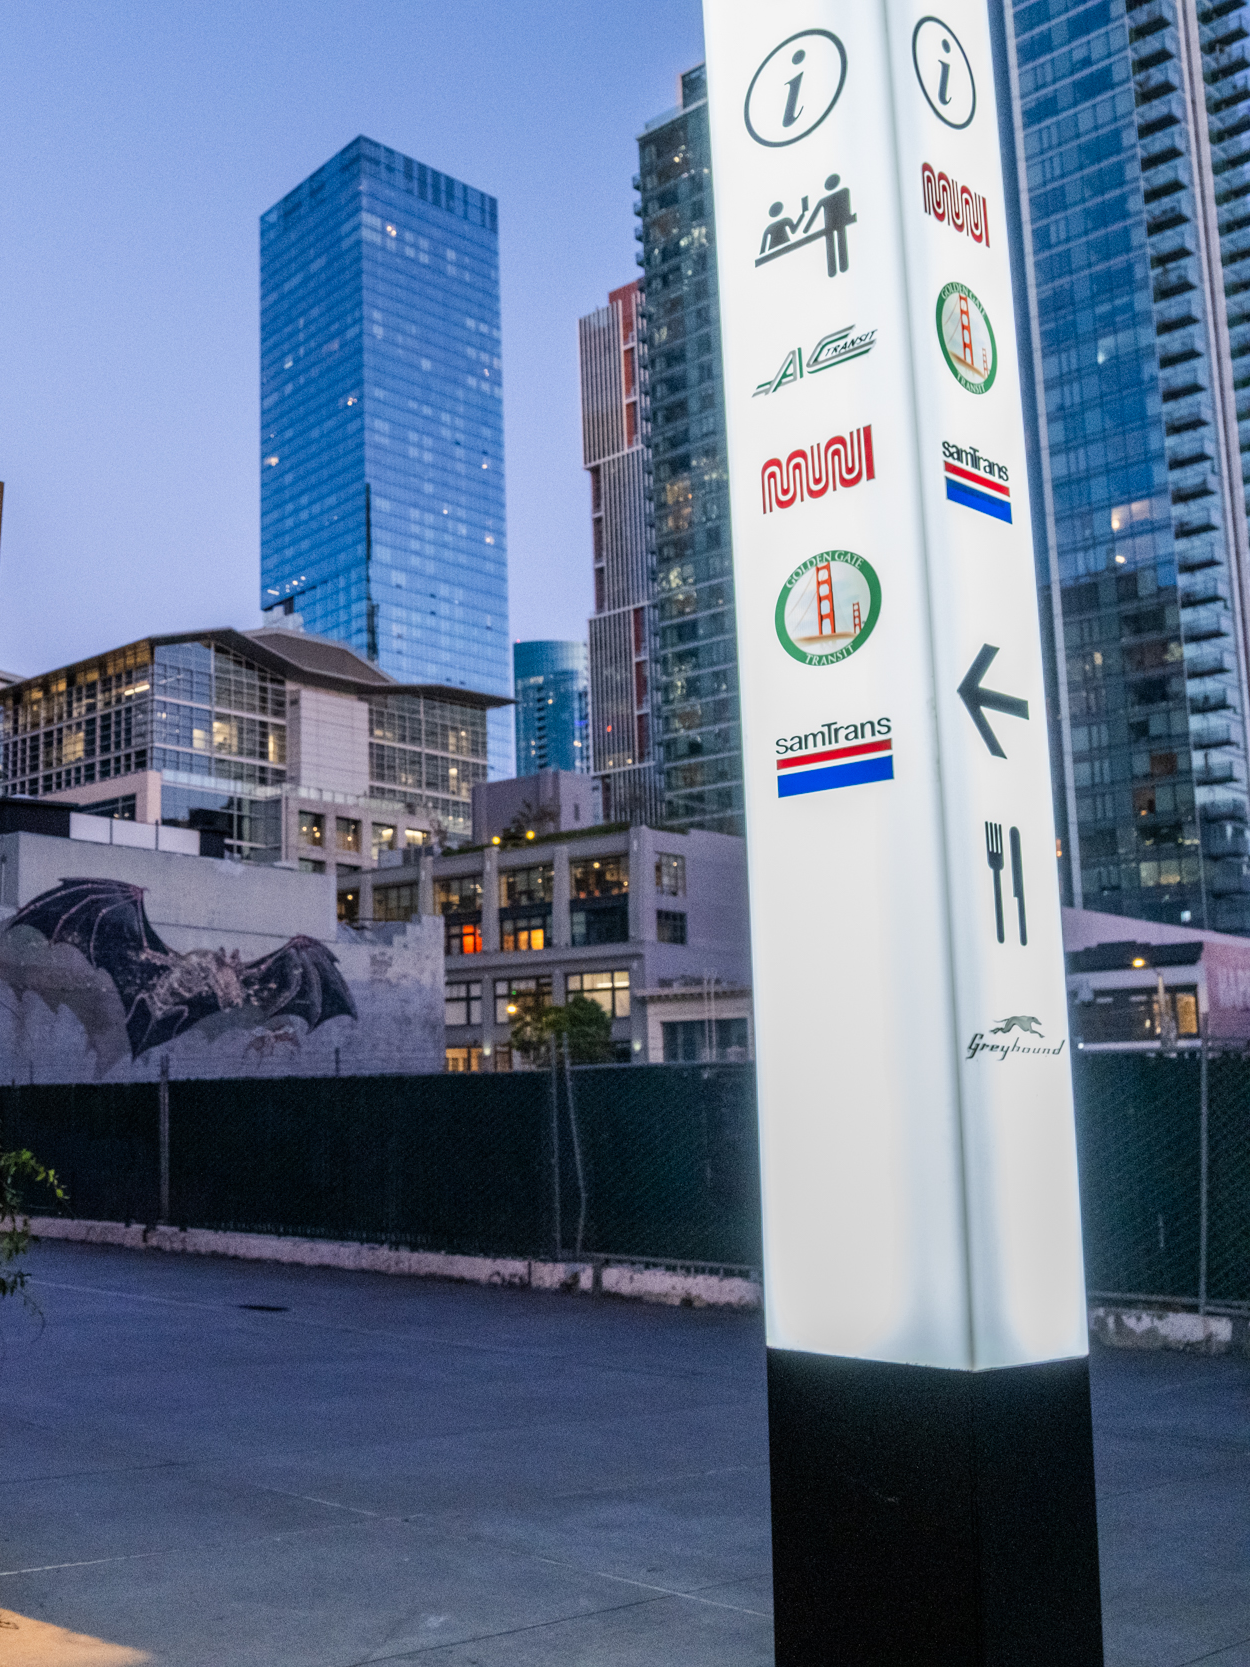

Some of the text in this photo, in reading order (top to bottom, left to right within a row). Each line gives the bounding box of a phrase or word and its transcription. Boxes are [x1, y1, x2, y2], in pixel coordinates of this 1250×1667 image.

[922, 162, 990, 248] MUNI
[941, 283, 986, 318] GOLDEN GATE
[751, 323, 878, 398] AC TRANSIT
[957, 372, 986, 395] TRANSIT
[761, 424, 876, 515] MUNI
[942, 441, 1009, 482] samTrans
[785, 550, 865, 589] GOLDEN GATE
[804, 642, 855, 667] TRANSIT
[775, 717, 892, 755] samTrans
[965, 1033, 1066, 1061] Greyhound
